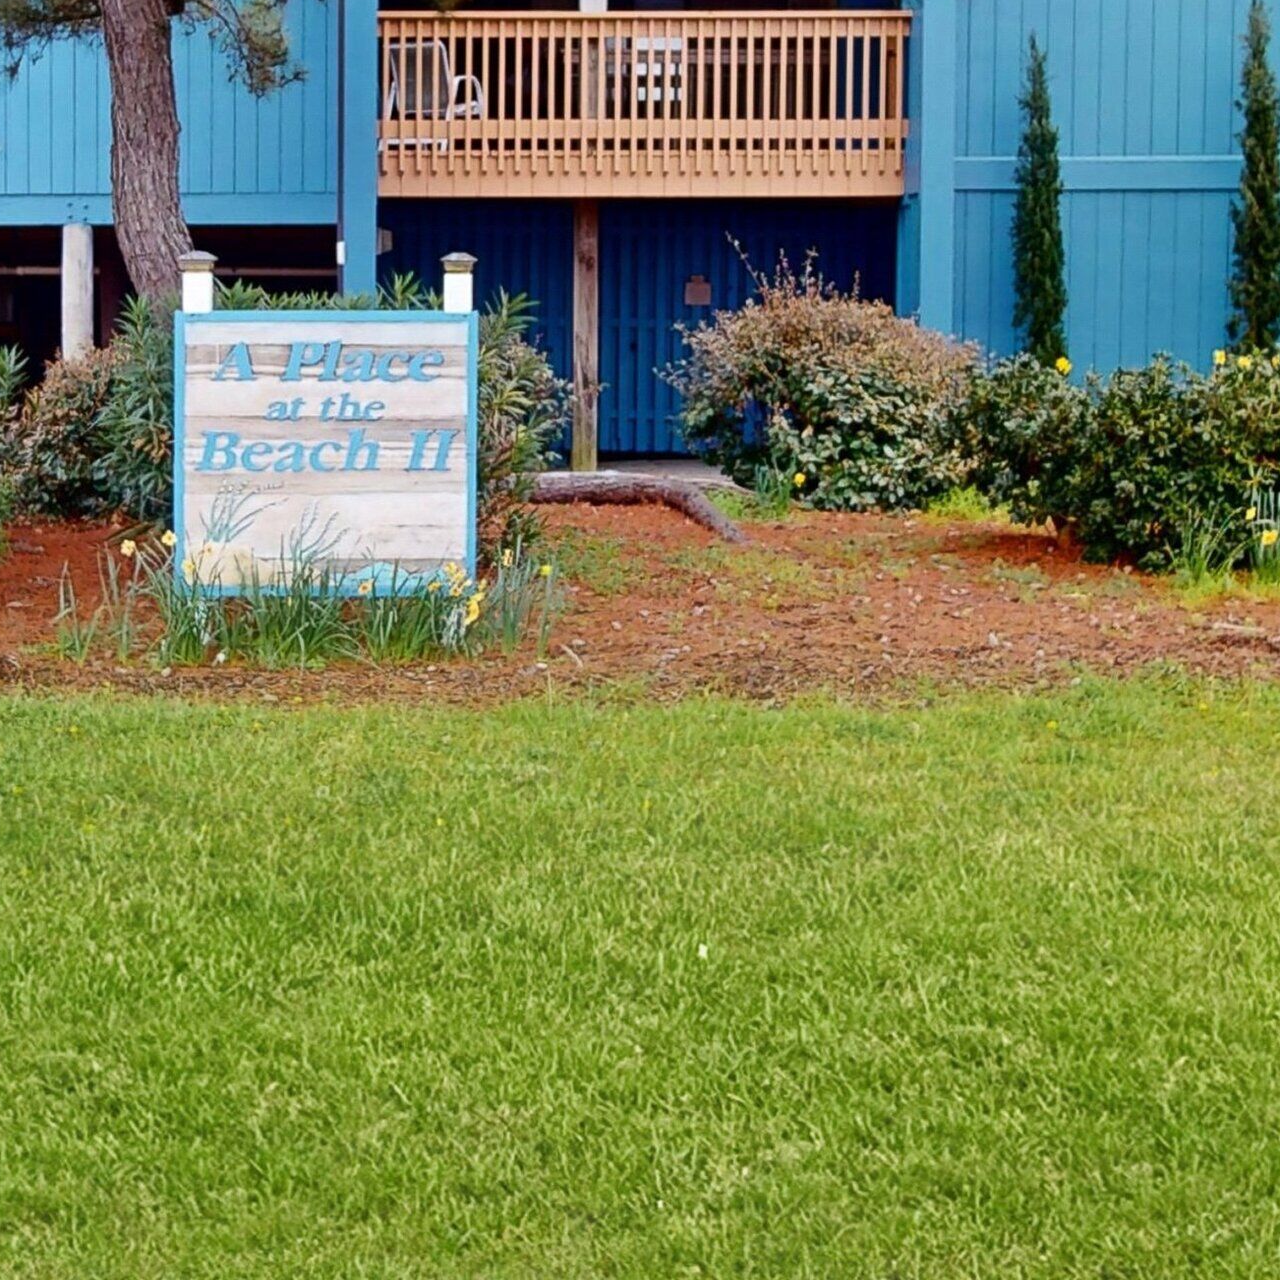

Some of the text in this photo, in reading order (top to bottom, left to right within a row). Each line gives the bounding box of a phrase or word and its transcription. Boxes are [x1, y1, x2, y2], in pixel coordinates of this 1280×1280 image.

[212, 339, 446, 382] A Place
[265, 393, 386, 421] at the
[195, 427, 460, 472] Beach II
